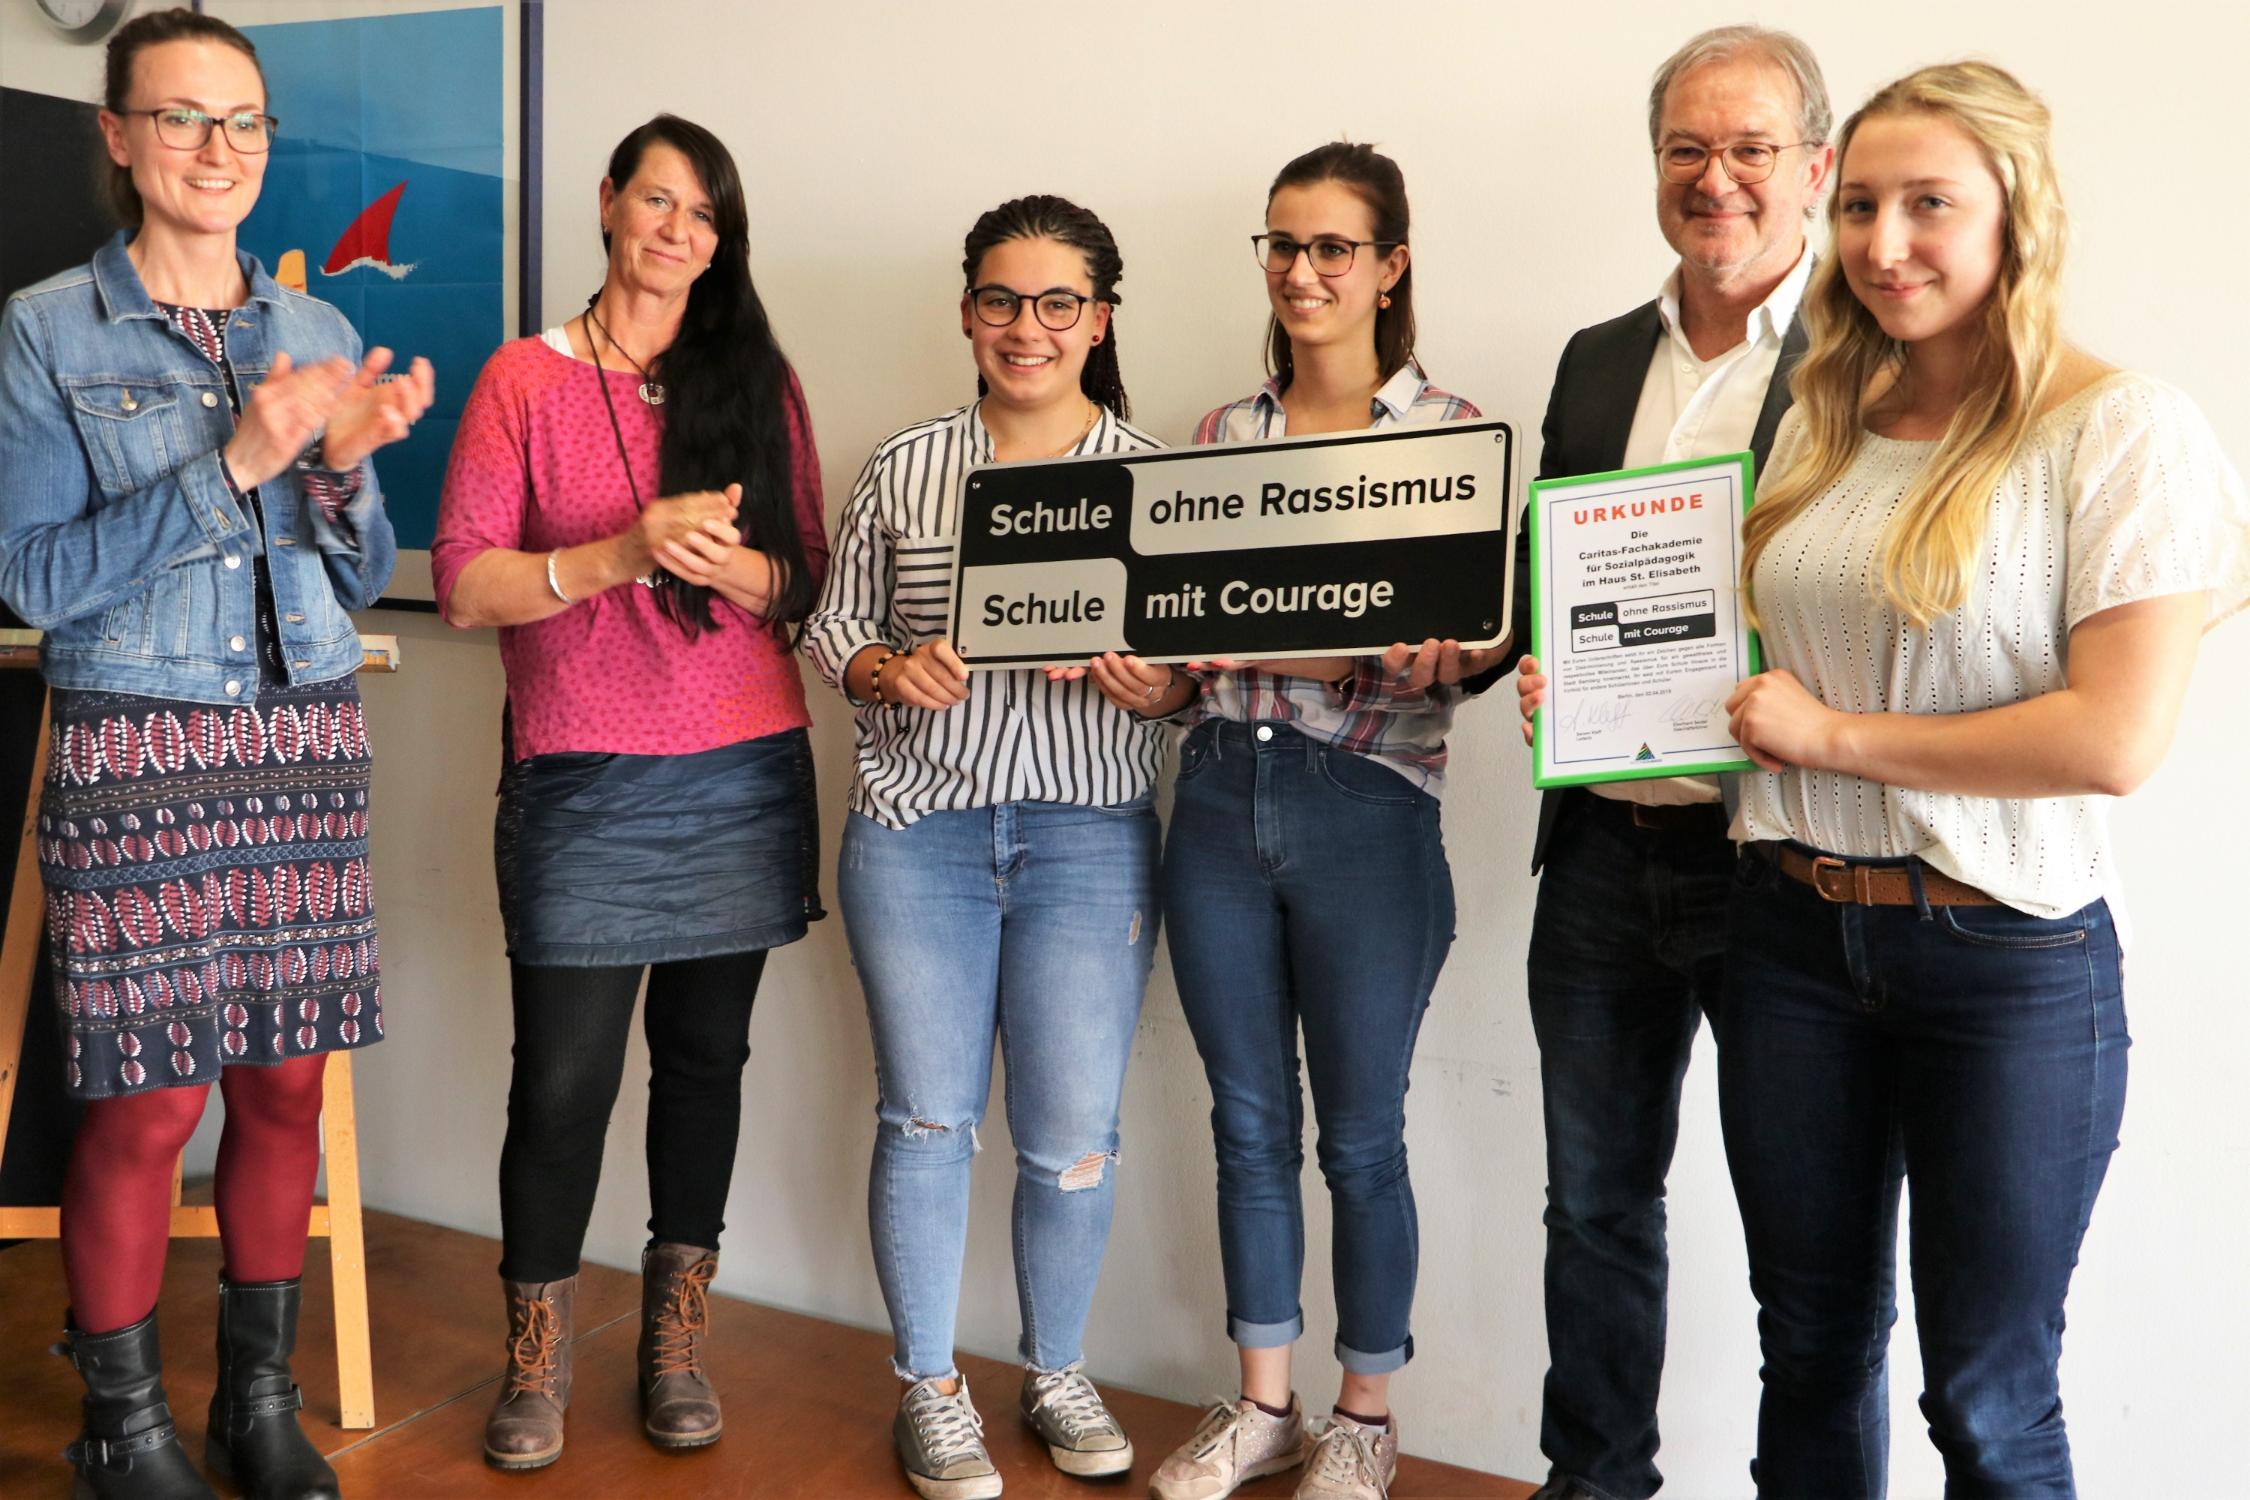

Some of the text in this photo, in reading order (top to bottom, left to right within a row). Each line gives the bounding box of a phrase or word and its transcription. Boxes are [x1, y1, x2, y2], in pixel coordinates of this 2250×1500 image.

[989, 471, 1477, 536] Schule ohne Rassismus
[1573, 493, 1704, 525] URKUNDE
[1631, 530, 1649, 539] Die
[1579, 536, 1703, 560] Caritas-Fachakademie
[1586, 551, 1696, 574] für Sozialpädagogik
[1582, 577, 1596, 588] im
[1599, 574, 1627, 586] Haus
[1630, 571, 1646, 581] St.
[1649, 565, 1701, 579] Elisabeth
[982, 578, 1395, 627] Schule mit Courage
[1578, 599, 1708, 622] Schule ohne Rassismus
[1579, 624, 1689, 645] Schule mit Courage
